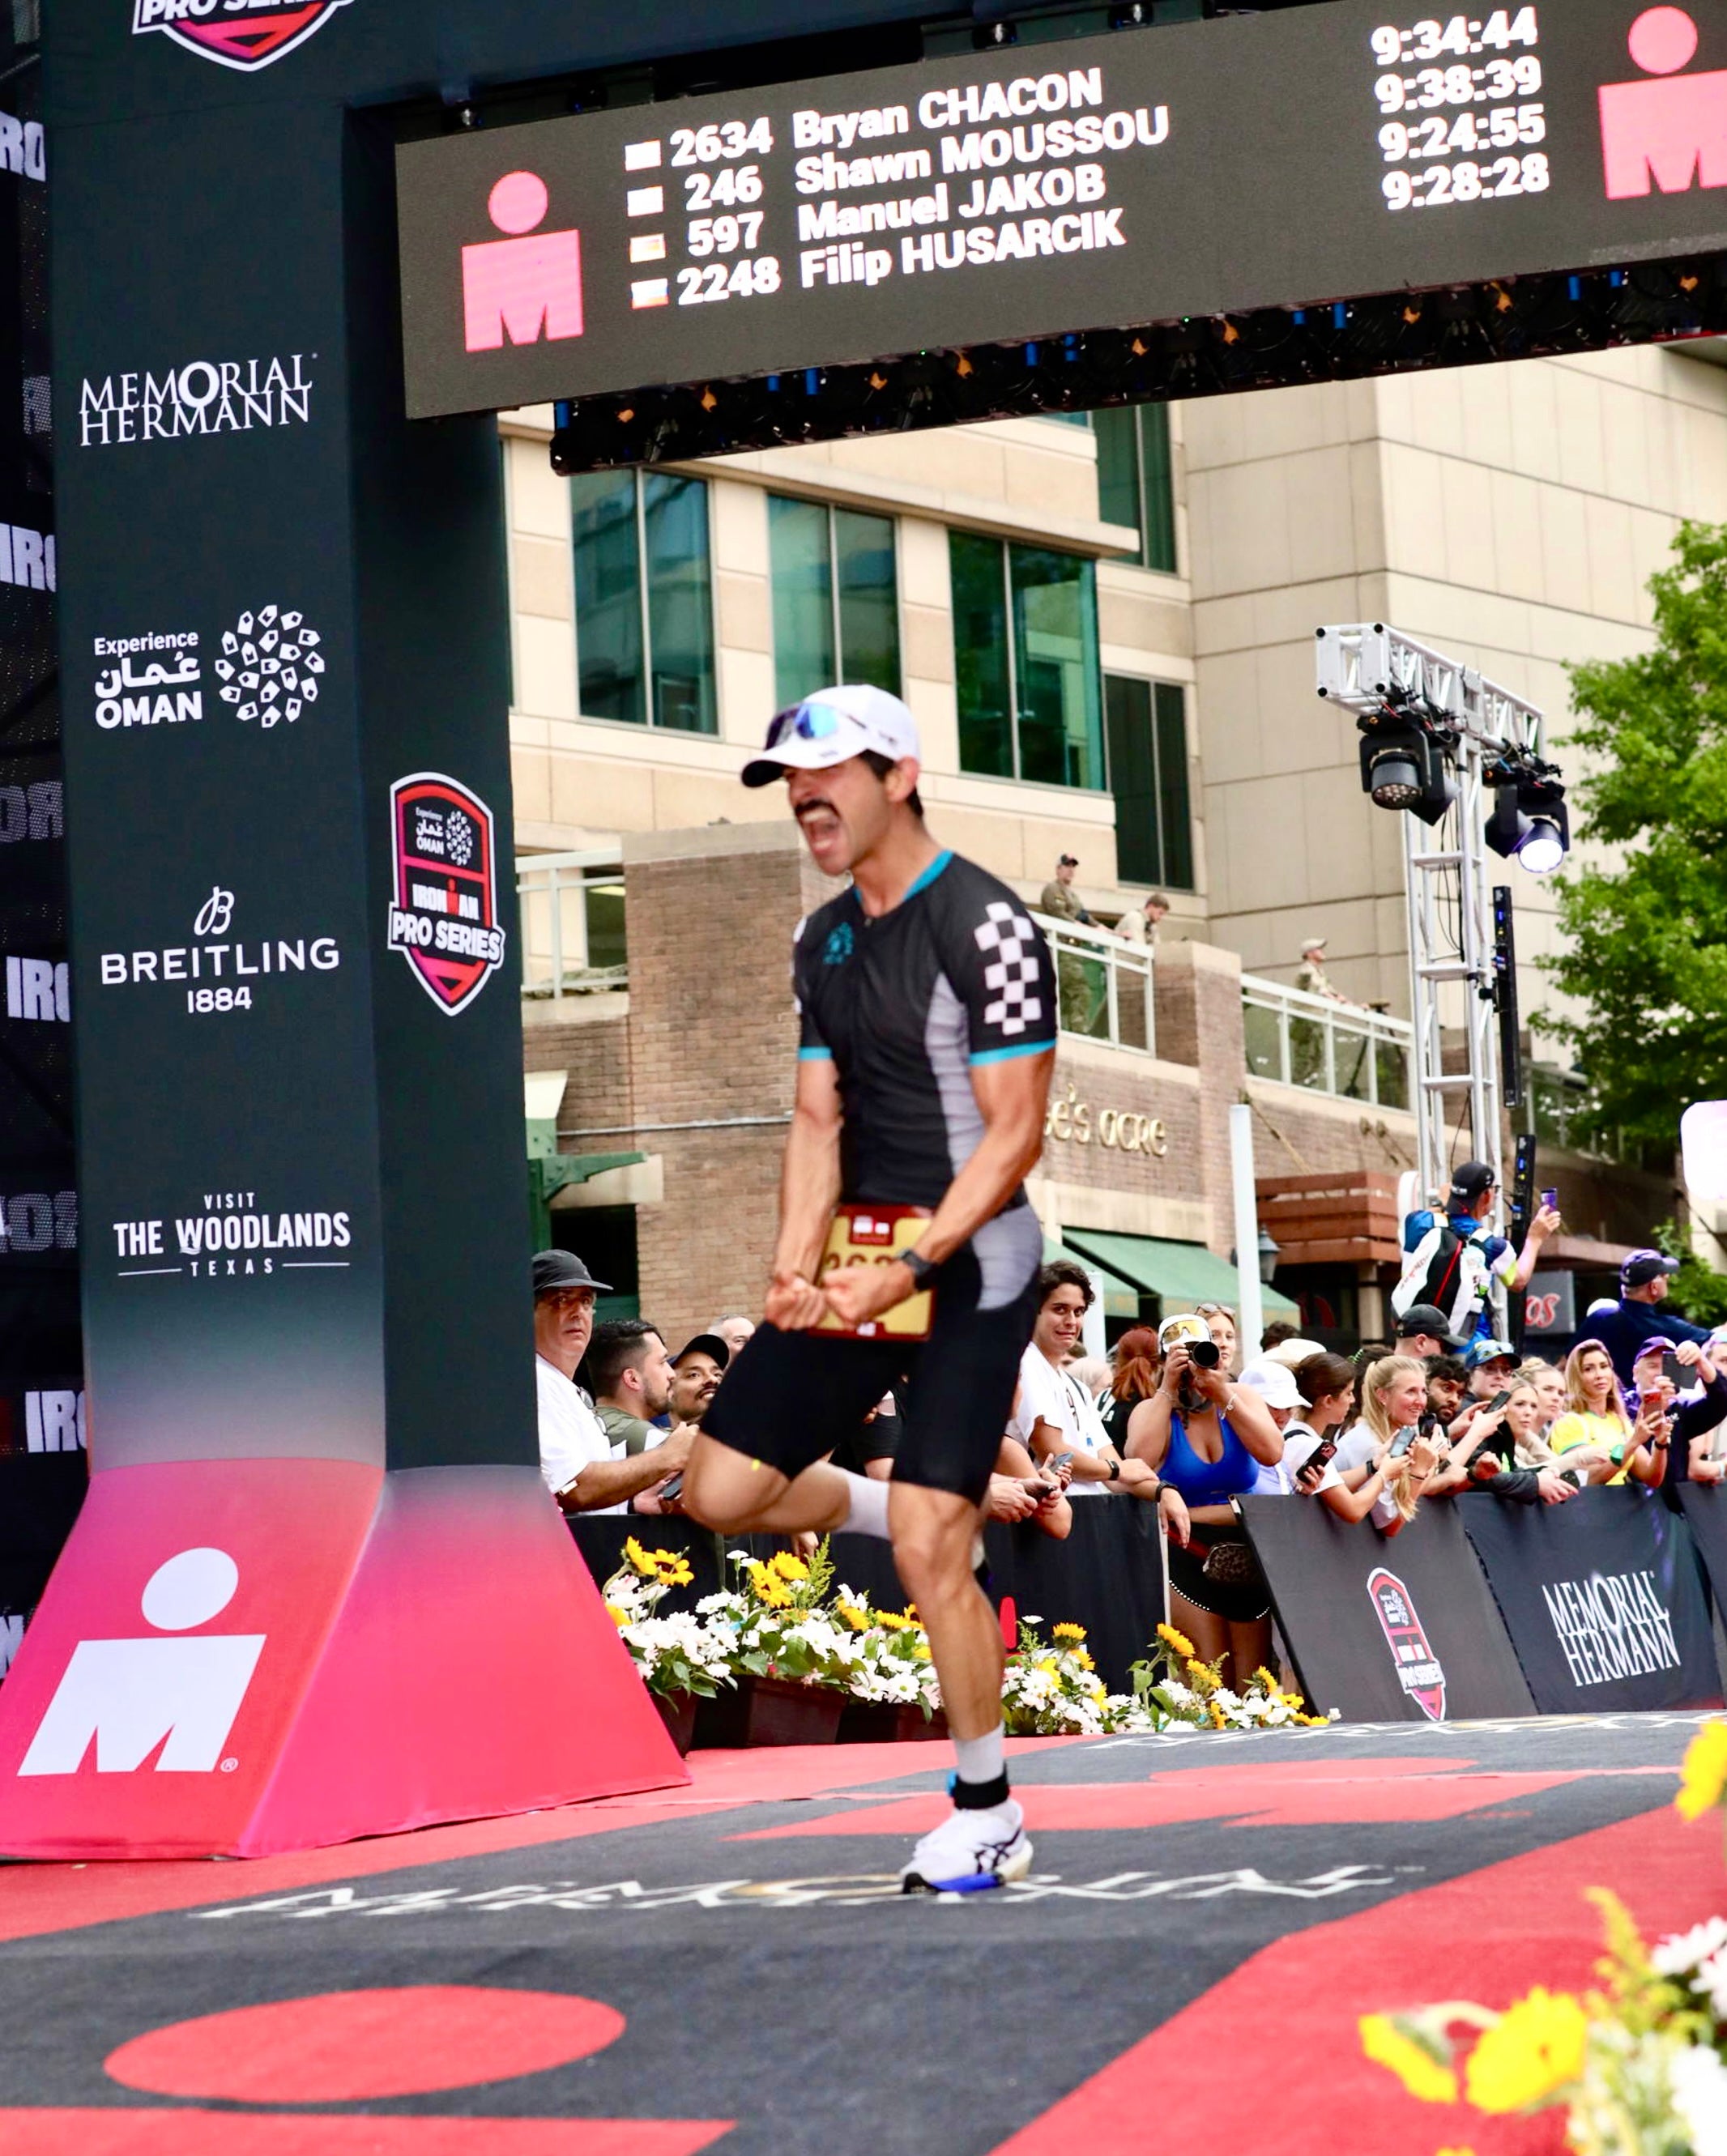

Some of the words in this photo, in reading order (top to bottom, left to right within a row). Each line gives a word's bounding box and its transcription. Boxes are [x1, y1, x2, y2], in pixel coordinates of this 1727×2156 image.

[670, 117, 774, 167] 2634
[792, 106, 909, 149] Bryan
[919, 67, 1102, 129] CHACON
[1371, 6, 1537, 65] 9:34:44
[684, 165, 762, 211] 246
[795, 149, 932, 194] Shawn
[940, 105, 1169, 174] MOUSSOU
[1375, 56, 1542, 113] 9:38:39
[688, 211, 764, 257] 597
[798, 183, 949, 241] Manuel
[958, 164, 1107, 218] JAKOB
[1379, 103, 1546, 162] 9:24:55
[676, 256, 781, 305] 2248
[800, 241, 892, 288] Filip
[901, 207, 1127, 274] HUSARCIK
[1382, 152, 1550, 211] 9:28:28
[79, 354, 313, 415] MEMORIAL
[80, 387, 309, 446] HERMANN
[94, 632, 198, 658] Experience
[95, 691, 203, 729] OMAN
[100, 938, 340, 985] BREITLING
[392, 911, 433, 947] PRO
[435, 919, 501, 961] SERIES
[187, 986, 253, 1014] 1884
[203, 1192, 255, 1210] VISIT
[113, 1221, 164, 1257] THE
[175, 1212, 352, 1255] WOODLANDS
[190, 1258, 274, 1277] TEXAS
[1542, 1570, 1670, 1639] MEMORIAL
[1558, 1618, 1682, 1687] HERMANN
